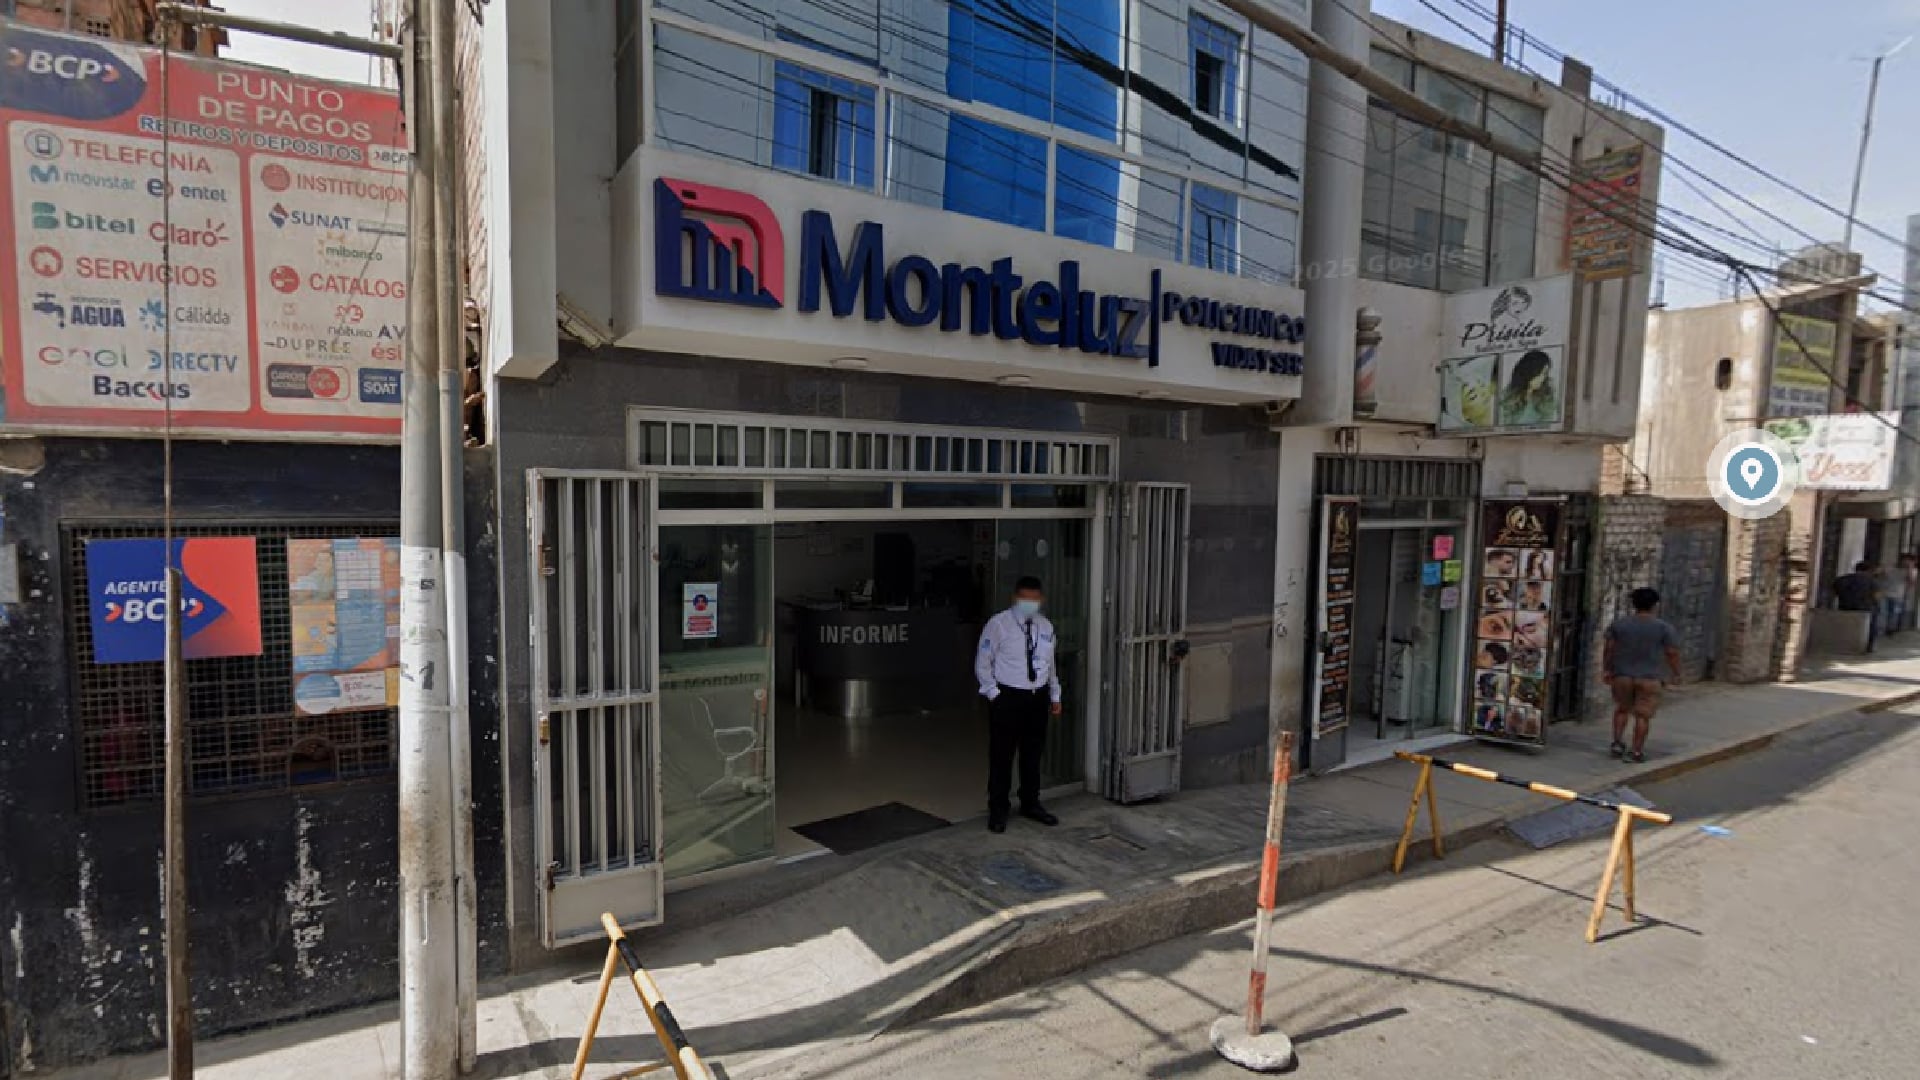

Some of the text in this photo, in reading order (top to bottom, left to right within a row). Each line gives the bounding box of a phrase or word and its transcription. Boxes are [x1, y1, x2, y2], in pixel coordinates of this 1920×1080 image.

[29, 51, 101, 80] BCP
[217, 72, 344, 112] PUNTO
[198, 96, 372, 140] DE PAGOS
[140, 117, 231, 143] RETIROS
[235, 129, 250, 146] Y
[64, 168, 136, 190] movistar
[180, 184, 227, 202] entel
[66, 210, 135, 234] bitel
[291, 210, 352, 230] SUNAT
[150, 222, 218, 247] Claro
[325, 245, 382, 261] mibanco
[76, 257, 217, 287] SERVICIOS
[798, 208, 1152, 359] Monteluz
[71, 305, 125, 327] AGUA
[363, 381, 398, 395] SOAT
[104, 581, 168, 595] AGENTE
[820, 624, 909, 644] INFORME
